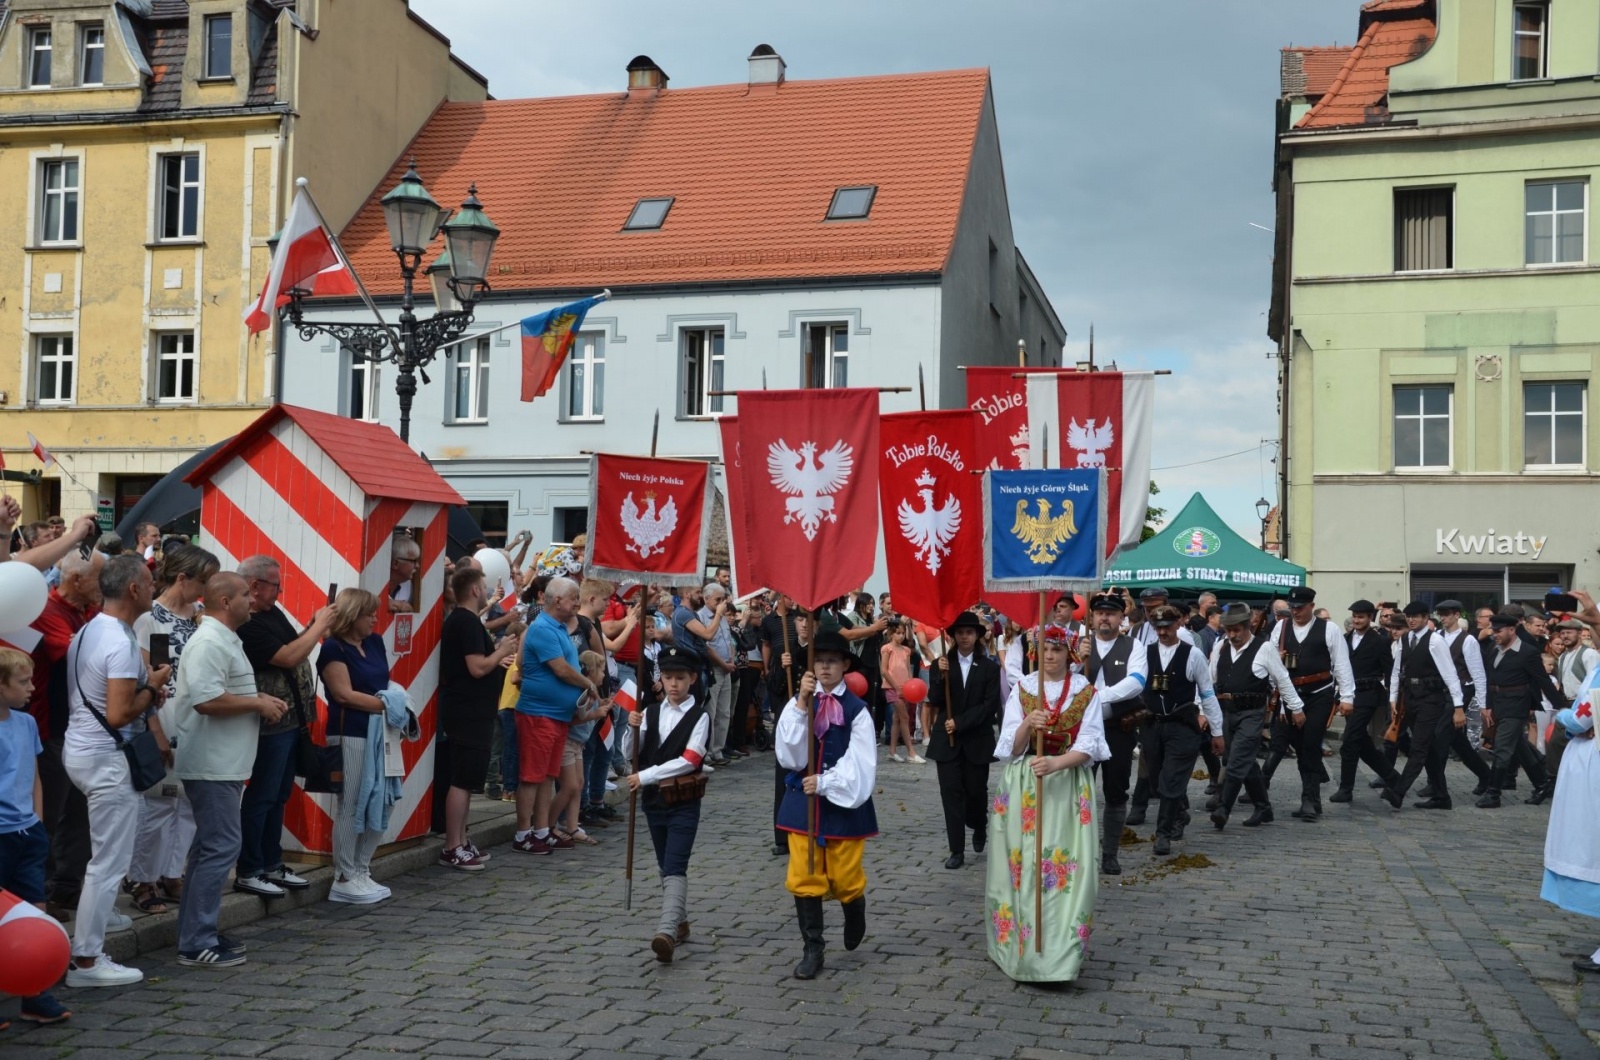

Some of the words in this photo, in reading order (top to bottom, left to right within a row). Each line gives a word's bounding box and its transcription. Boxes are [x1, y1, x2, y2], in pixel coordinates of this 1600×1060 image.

[971, 390, 1023, 425] Tobie
[885, 443, 925, 468] Tobie
[926, 434, 964, 471] Polsko
[619, 471, 640, 481] Niech
[642, 474, 657, 484] żyje
[660, 475, 684, 485] Polska
[1000, 485, 1021, 494] Niech
[1023, 485, 1039, 495] żyje
[1041, 484, 1066, 494] Górny
[1068, 482, 1089, 493] Śląsk
[1436, 528, 1548, 560] Kwiaty
[1136, 567, 1182, 580] ODDZIAŁ
[1186, 567, 1228, 581] STRAŻY
[1232, 571, 1300, 587] GRANICZNEJ
